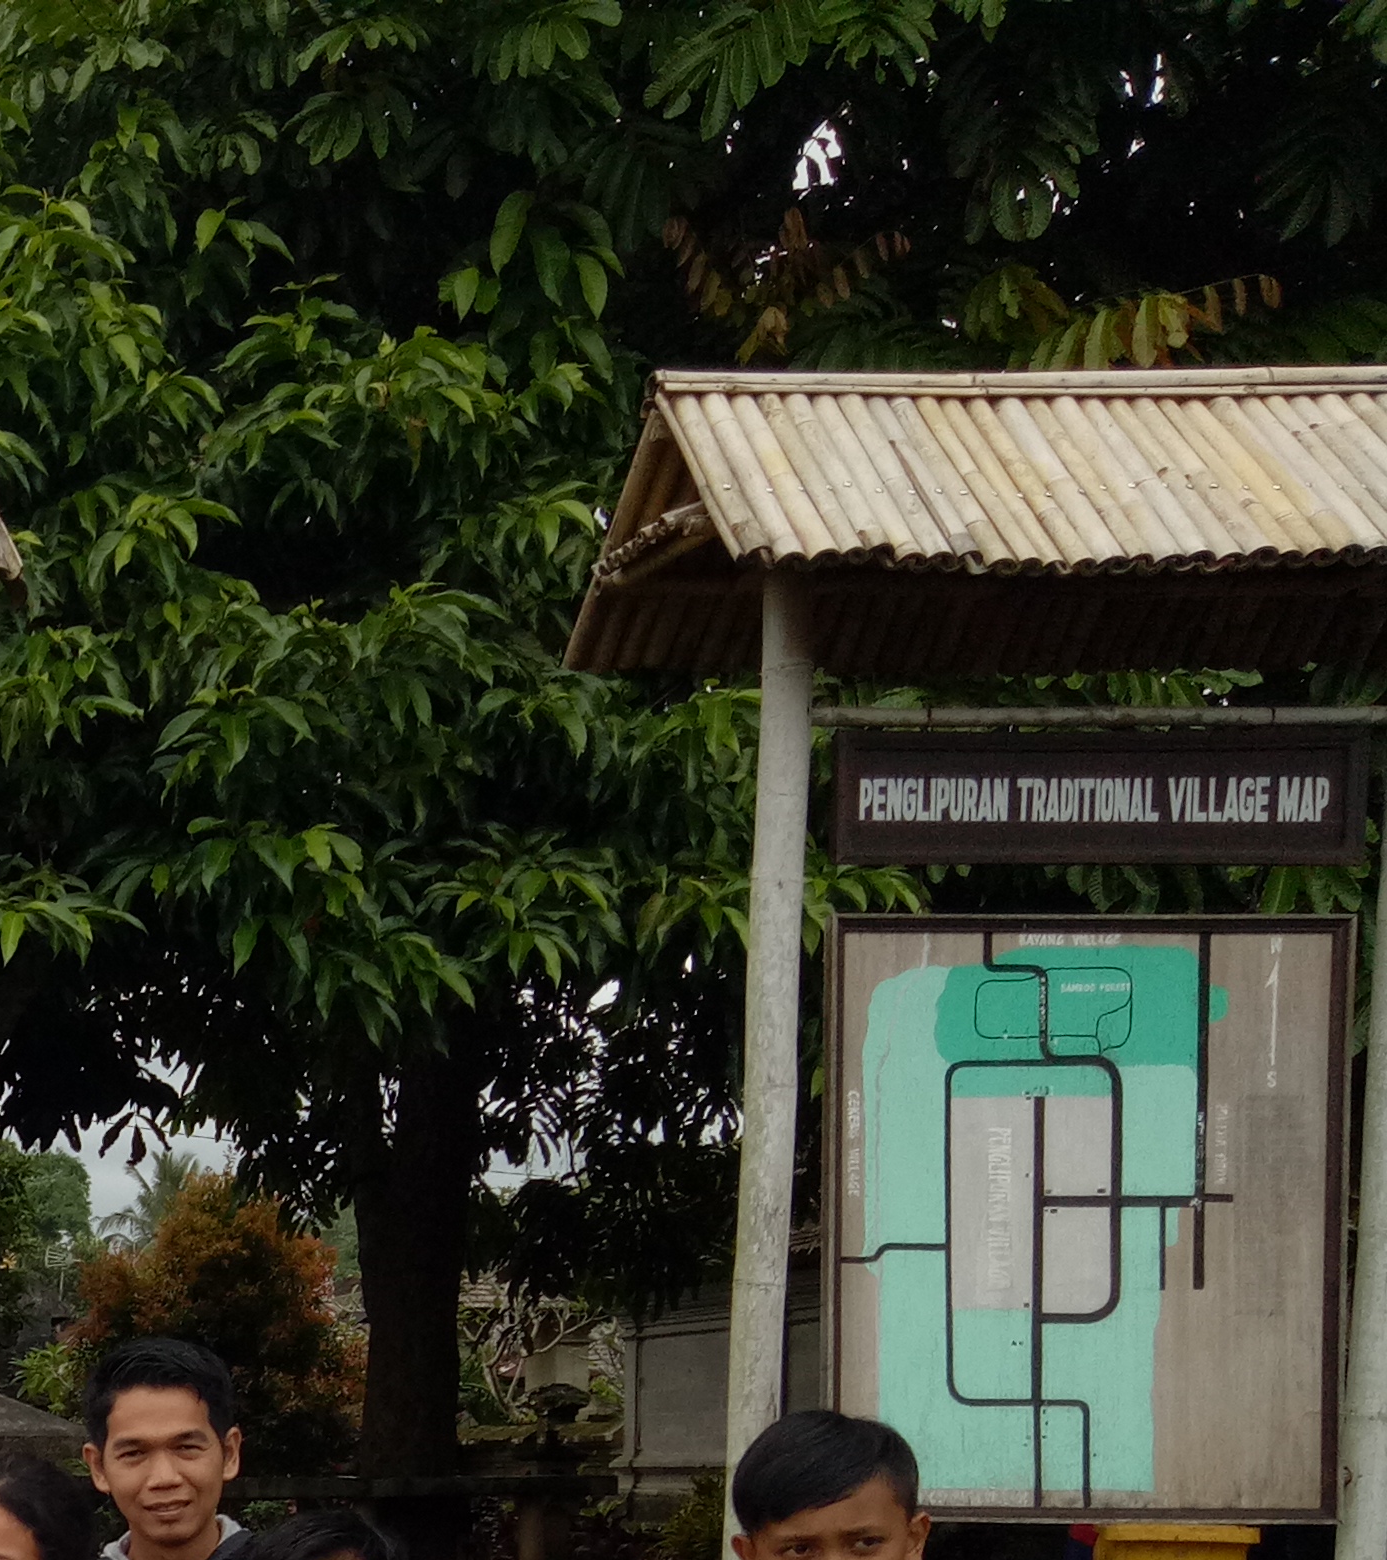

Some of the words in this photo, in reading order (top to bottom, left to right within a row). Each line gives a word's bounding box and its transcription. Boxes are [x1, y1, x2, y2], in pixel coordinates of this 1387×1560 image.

[859, 777, 1009, 822] PENGLIPURAN
[1018, 777, 1159, 822] TRADITIONAL
[1167, 777, 1270, 822] VILLAGE
[1277, 777, 1330, 822] MAP
[1074, 934, 1122, 945] VILLAGE
[1270, 937, 1284, 955] N
[1266, 1071, 1277, 1088] S
